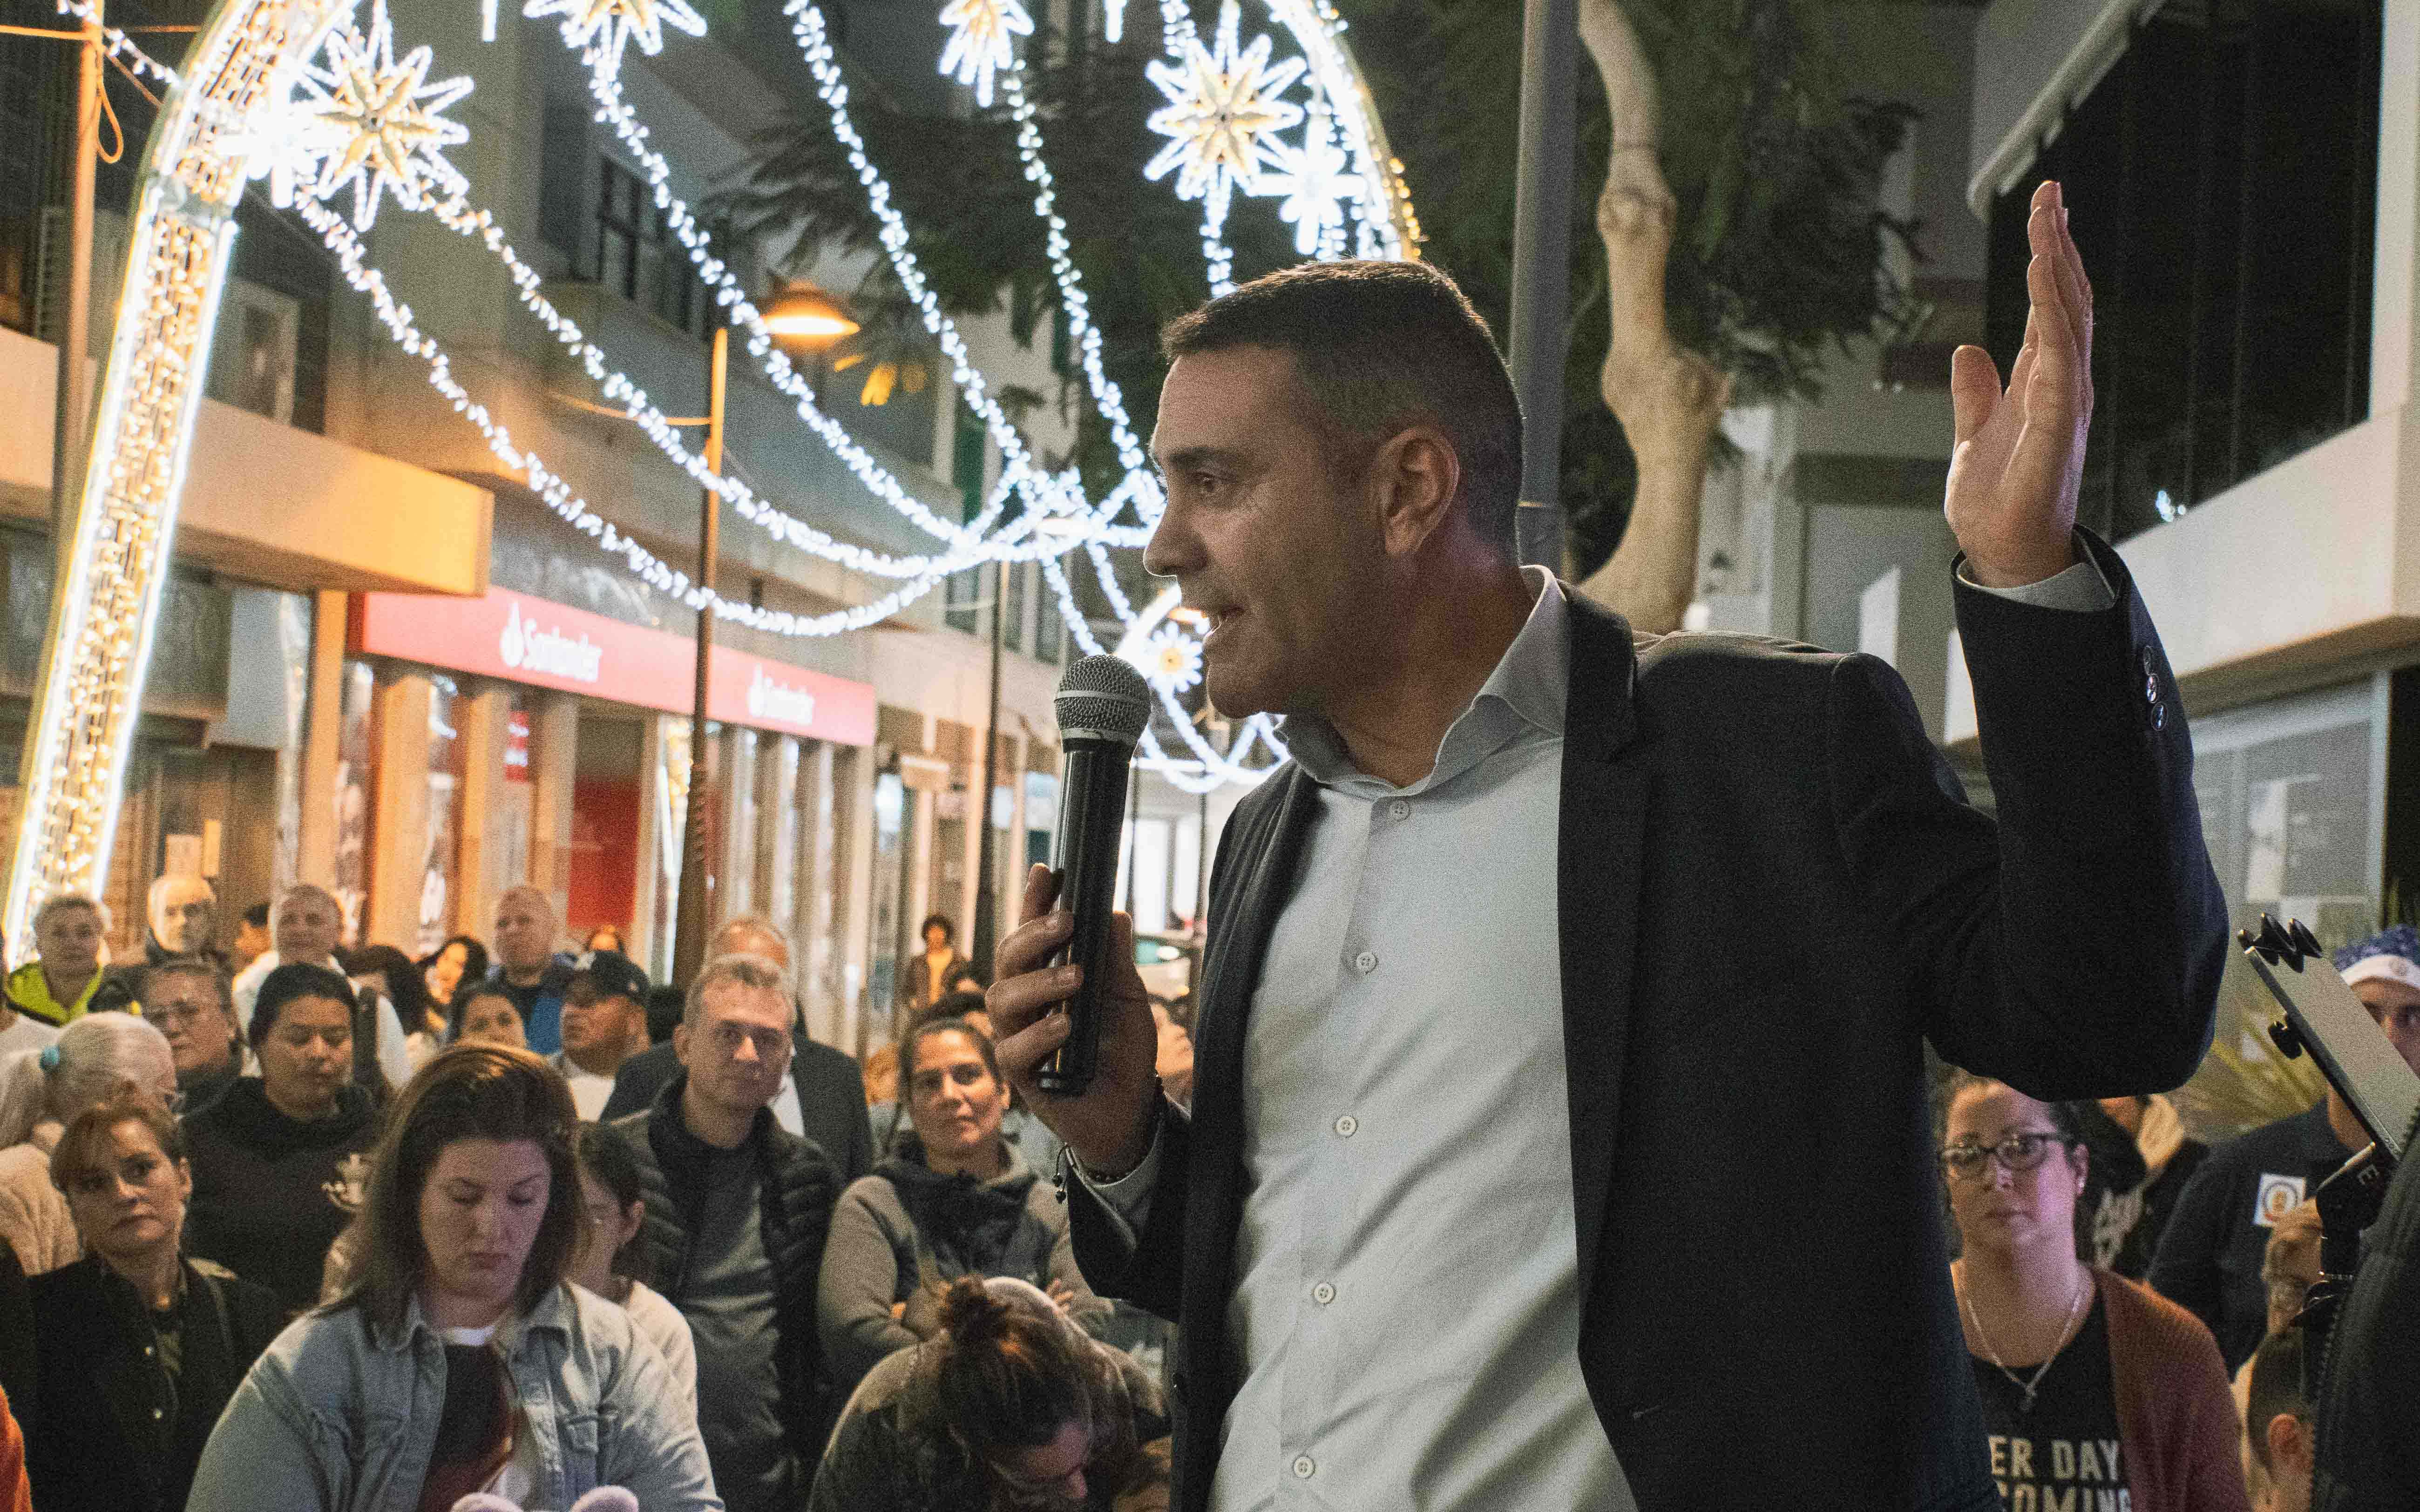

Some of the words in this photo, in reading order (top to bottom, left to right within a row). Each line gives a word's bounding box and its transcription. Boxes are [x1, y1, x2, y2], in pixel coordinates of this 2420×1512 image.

[522, 619, 602, 682] Santander
[2051, 1438, 2118, 1481] DAY
[1995, 1481, 2131, 1512] OMIN
